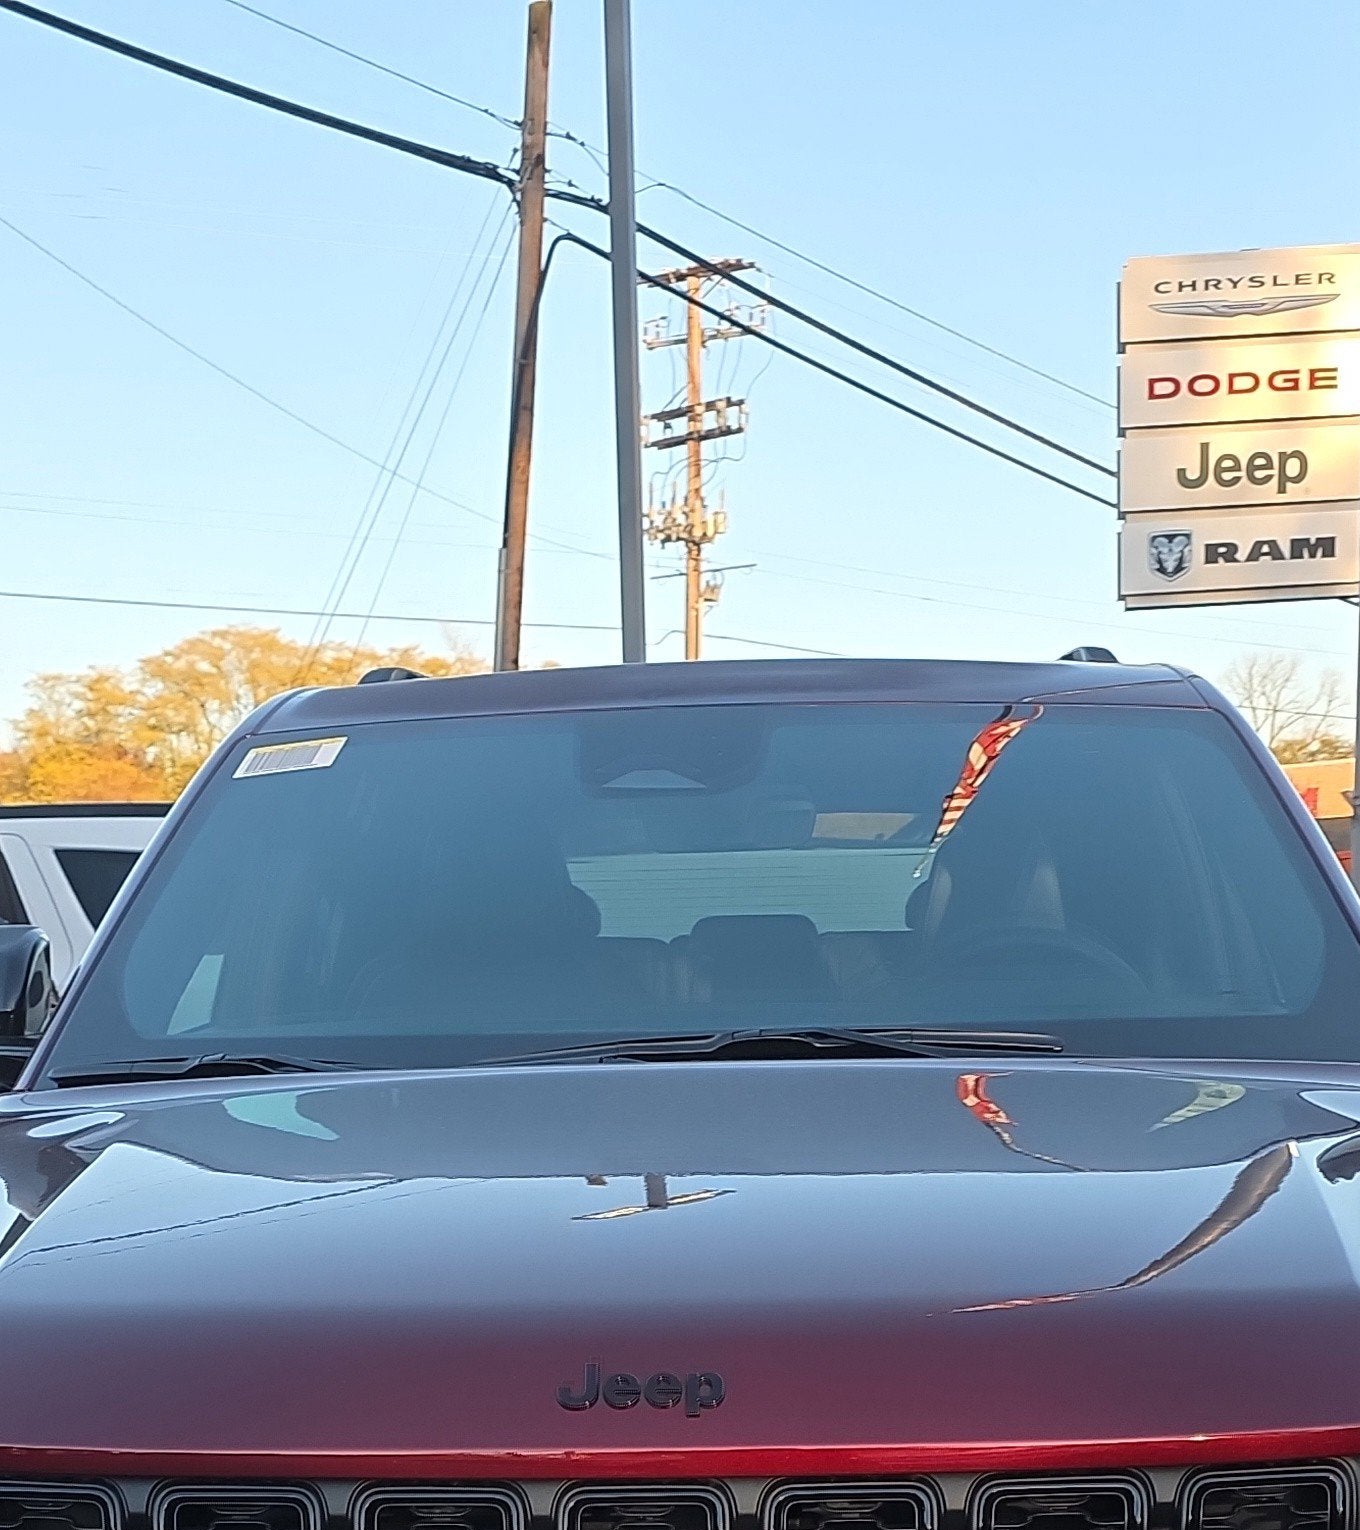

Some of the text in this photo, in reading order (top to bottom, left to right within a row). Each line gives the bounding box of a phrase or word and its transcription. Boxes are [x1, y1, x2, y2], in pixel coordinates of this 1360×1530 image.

[1154, 271, 1337, 294] CHRYSLER
[1147, 367, 1339, 400] DODGE
[1176, 441, 1309, 494] Jeep
[1203, 535, 1338, 565] RAM
[556, 1362, 726, 1418] Jeep
